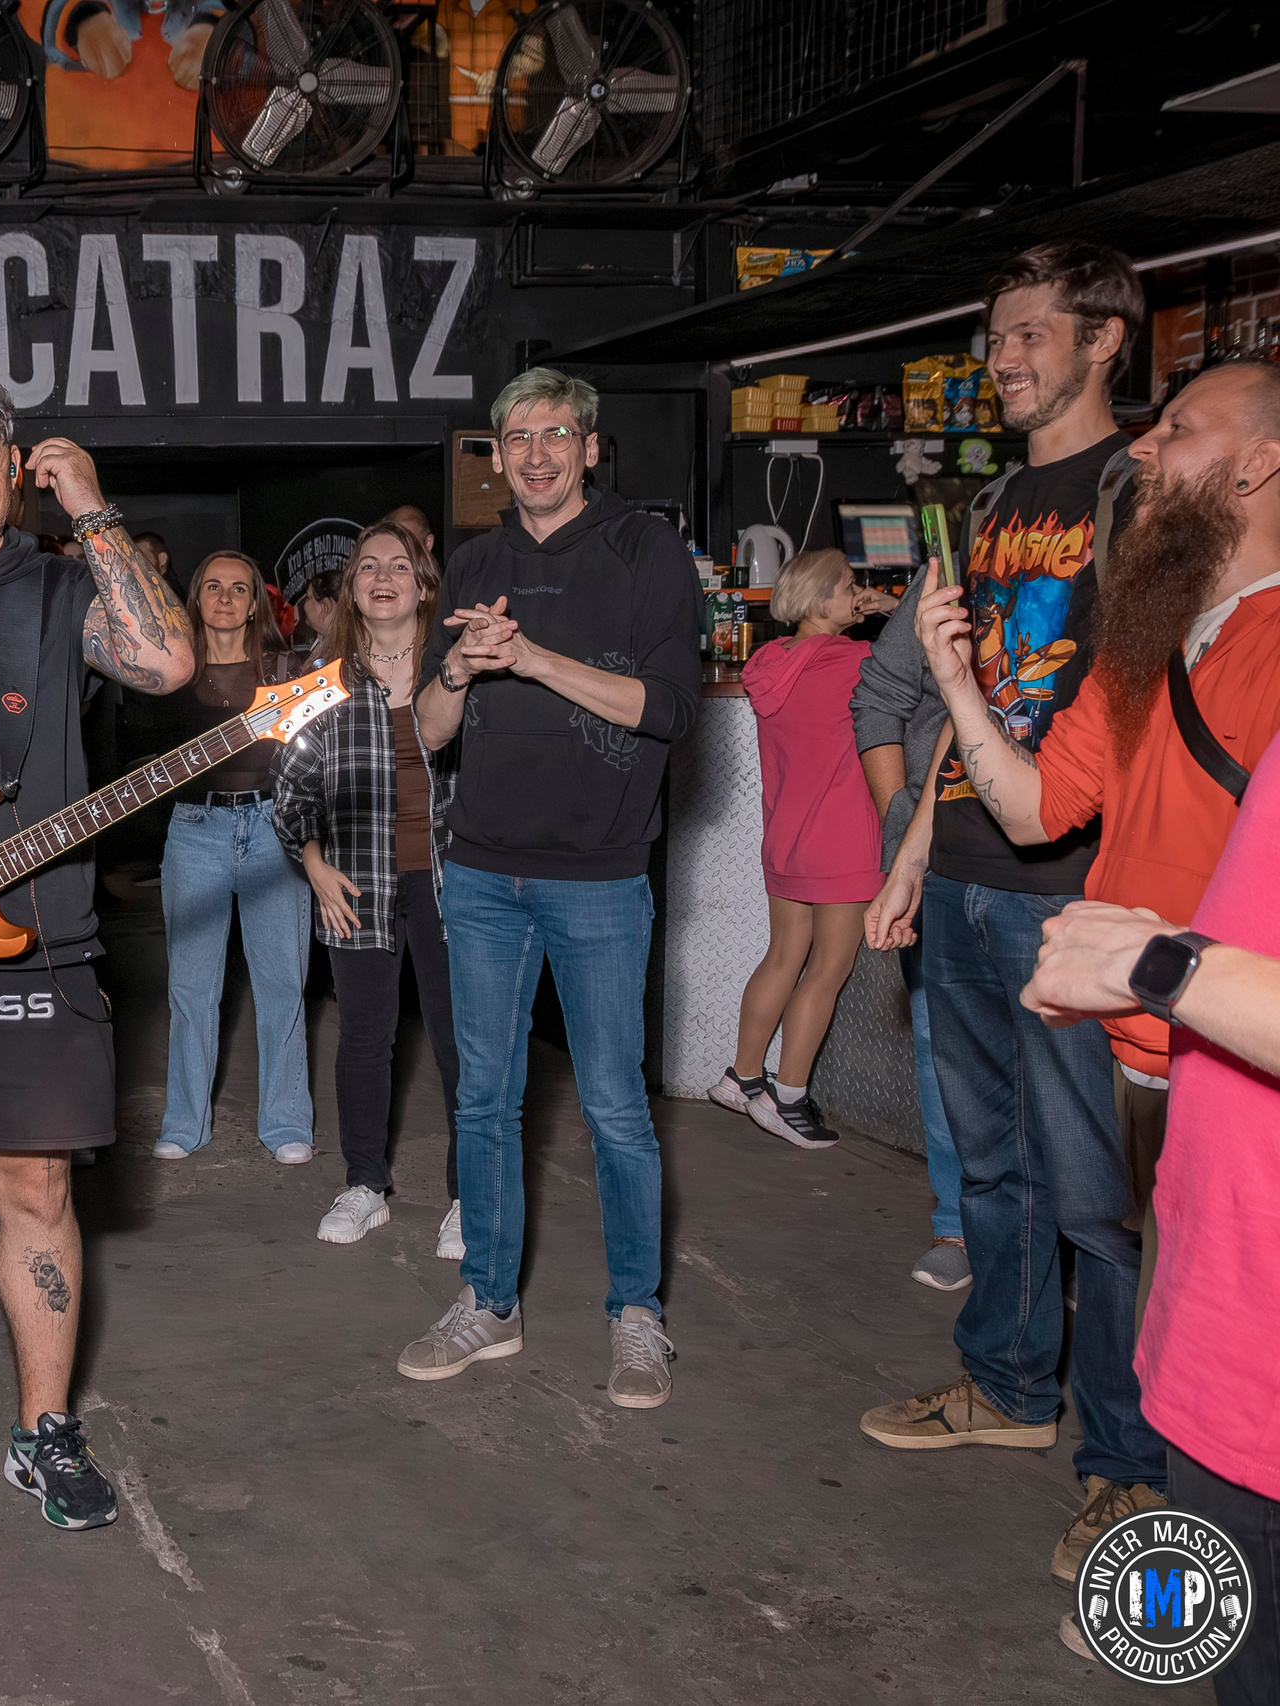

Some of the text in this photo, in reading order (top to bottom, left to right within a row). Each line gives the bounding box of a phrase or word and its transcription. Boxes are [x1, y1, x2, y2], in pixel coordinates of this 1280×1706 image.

[287, 534, 356, 577] КТО НЕ БЫЛ ЛИШЕ
